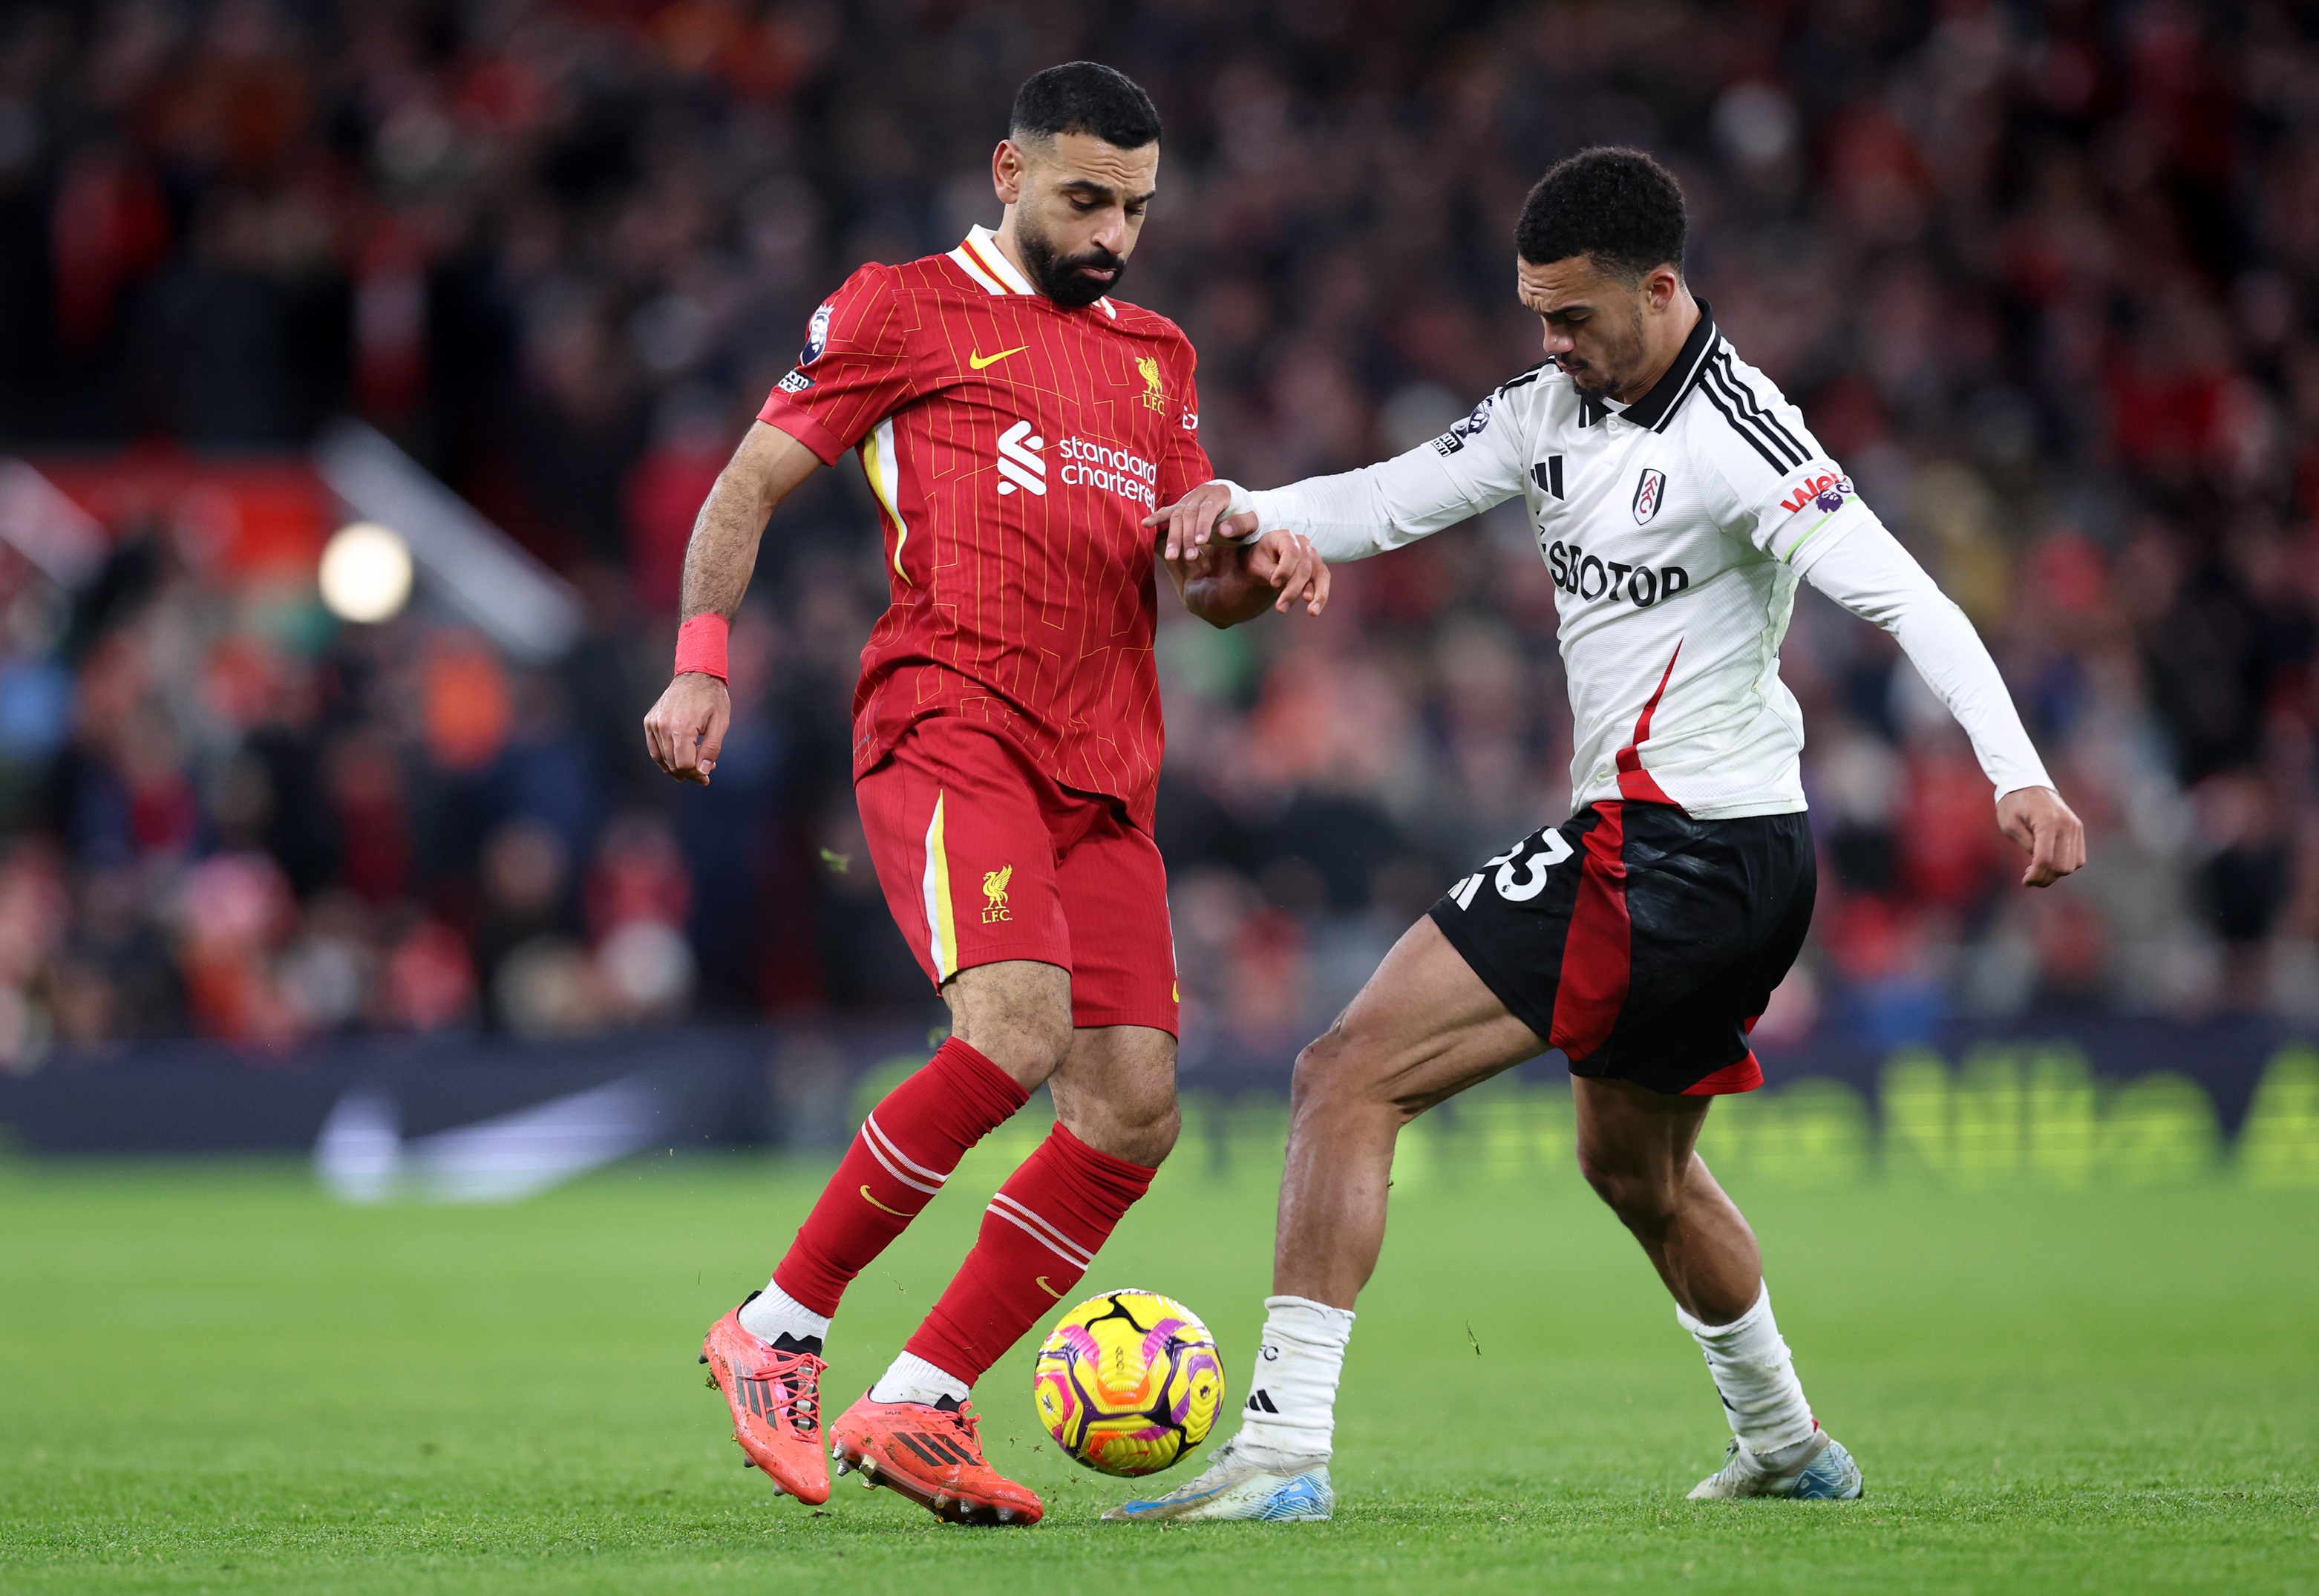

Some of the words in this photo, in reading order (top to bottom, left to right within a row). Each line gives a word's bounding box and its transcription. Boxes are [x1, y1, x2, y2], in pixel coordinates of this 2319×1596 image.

[1059, 436, 1157, 486] standard
[1061, 460, 1156, 514] chartered
[1639, 475, 1658, 514] FFC
[981, 909, 1013, 924] L.F.C.
